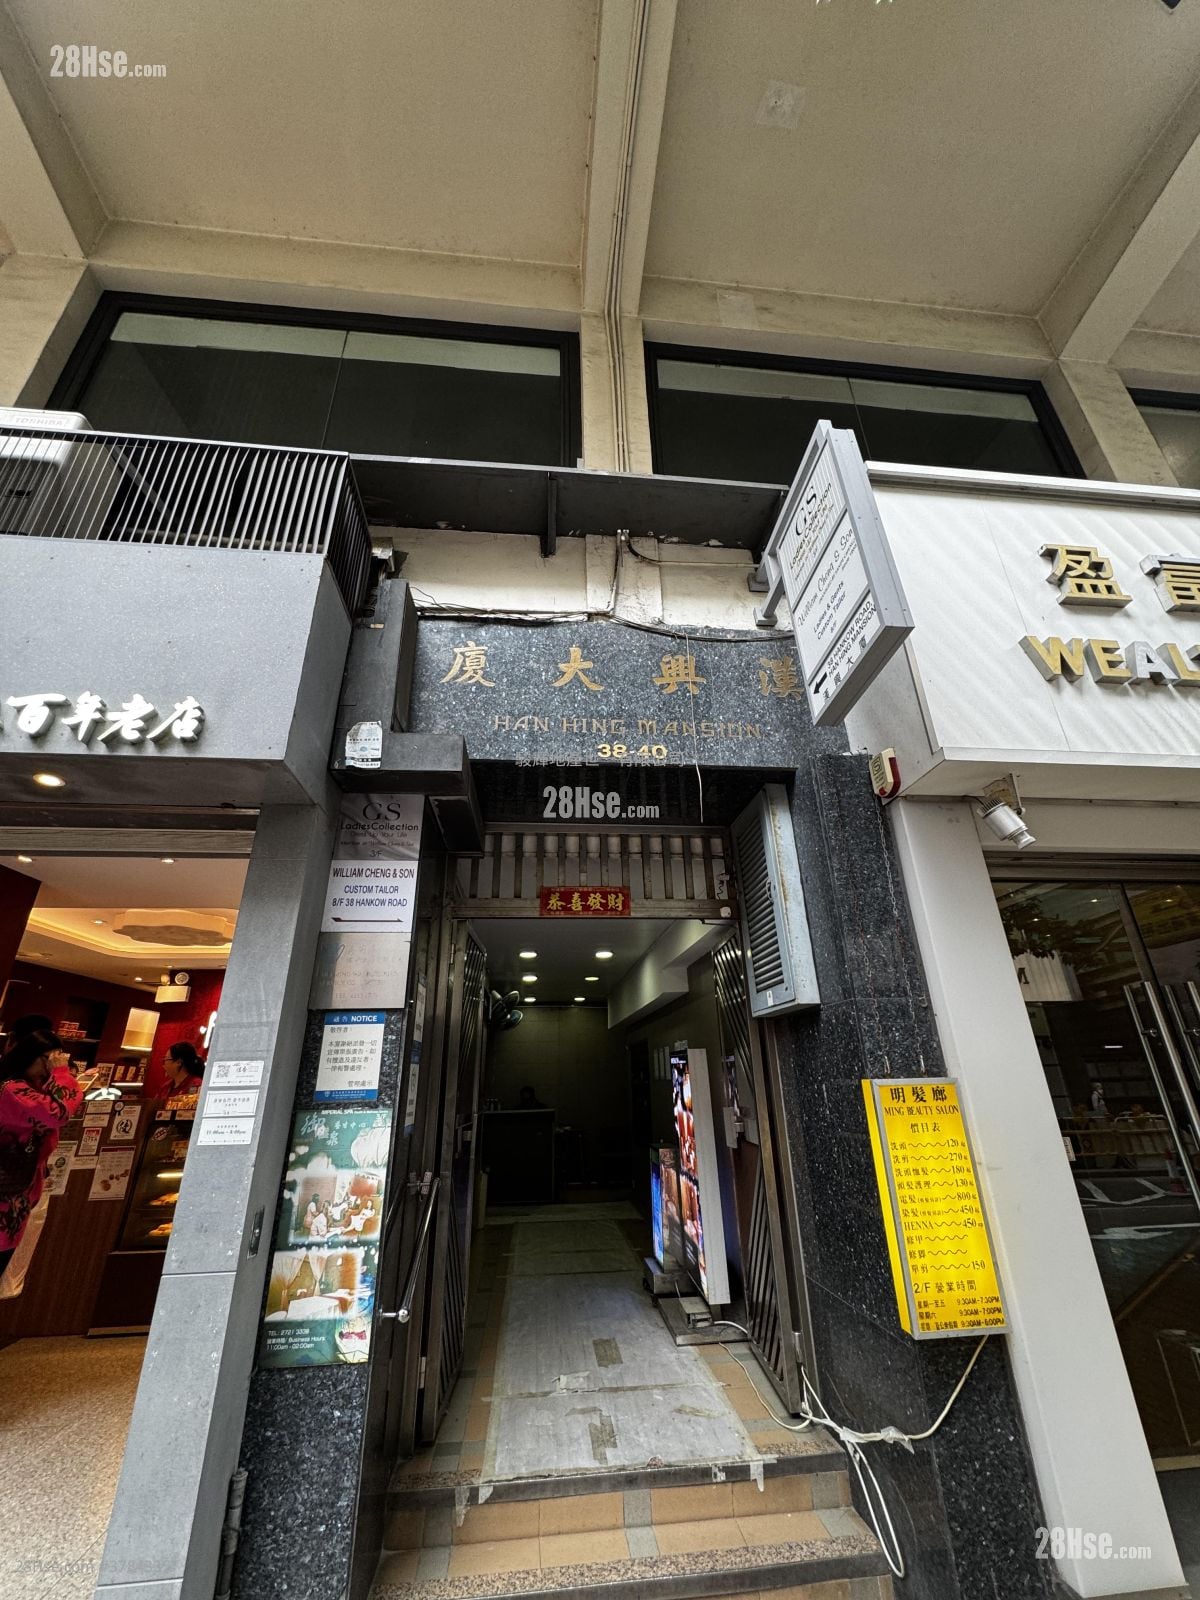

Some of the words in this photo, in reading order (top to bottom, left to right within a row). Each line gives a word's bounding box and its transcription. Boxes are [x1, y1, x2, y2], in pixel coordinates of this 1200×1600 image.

[16, 418, 62, 426] TOSHIBA
[828, 658, 839, 678] HAN
[838, 640, 851, 664] HING
[850, 602, 876, 646] MANSION
[833, 622, 855, 661] HANKOW
[1019, 636, 1200, 687] WEAL
[6, 691, 205, 746] 百年老店
[494, 714, 550, 732] HAN
[562, 718, 626, 734] HING
[638, 720, 760, 738] MANSION
[363, 802, 401, 821] GS
[332, 868, 364, 878] WILLIAM
[365, 868, 391, 878] CHENG
[392, 868, 398, 878] &
[399, 868, 414, 878] SON
[344, 885, 373, 894] CUSTOM
[375, 885, 399, 894] TAILOR
[345, 898, 354, 907] 38
[355, 898, 387, 907] HANKOW
[388, 898, 407, 907] ROAD
[547, 892, 624, 911] 恭喜發財
[890, 1086, 947, 1103] 明髮廊
[884, 1107, 904, 1116] MING
[907, 1106, 933, 1115] BEAUTY
[936, 1104, 959, 1114] SALON
[947, 1139, 958, 1147] 120
[949, 1153, 962, 1161] 270
[952, 1166, 964, 1174] 180
[955, 1179, 968, 1187] 130
[957, 1192, 970, 1200] 800
[960, 1205, 973, 1214] 450
[904, 1221, 933, 1231] HENNA
[963, 1218, 976, 1228] 450
[972, 1261, 985, 1270] 150
[913, 1282, 930, 1293] 2/F
[936, 1280, 976, 1294] 營業時間
